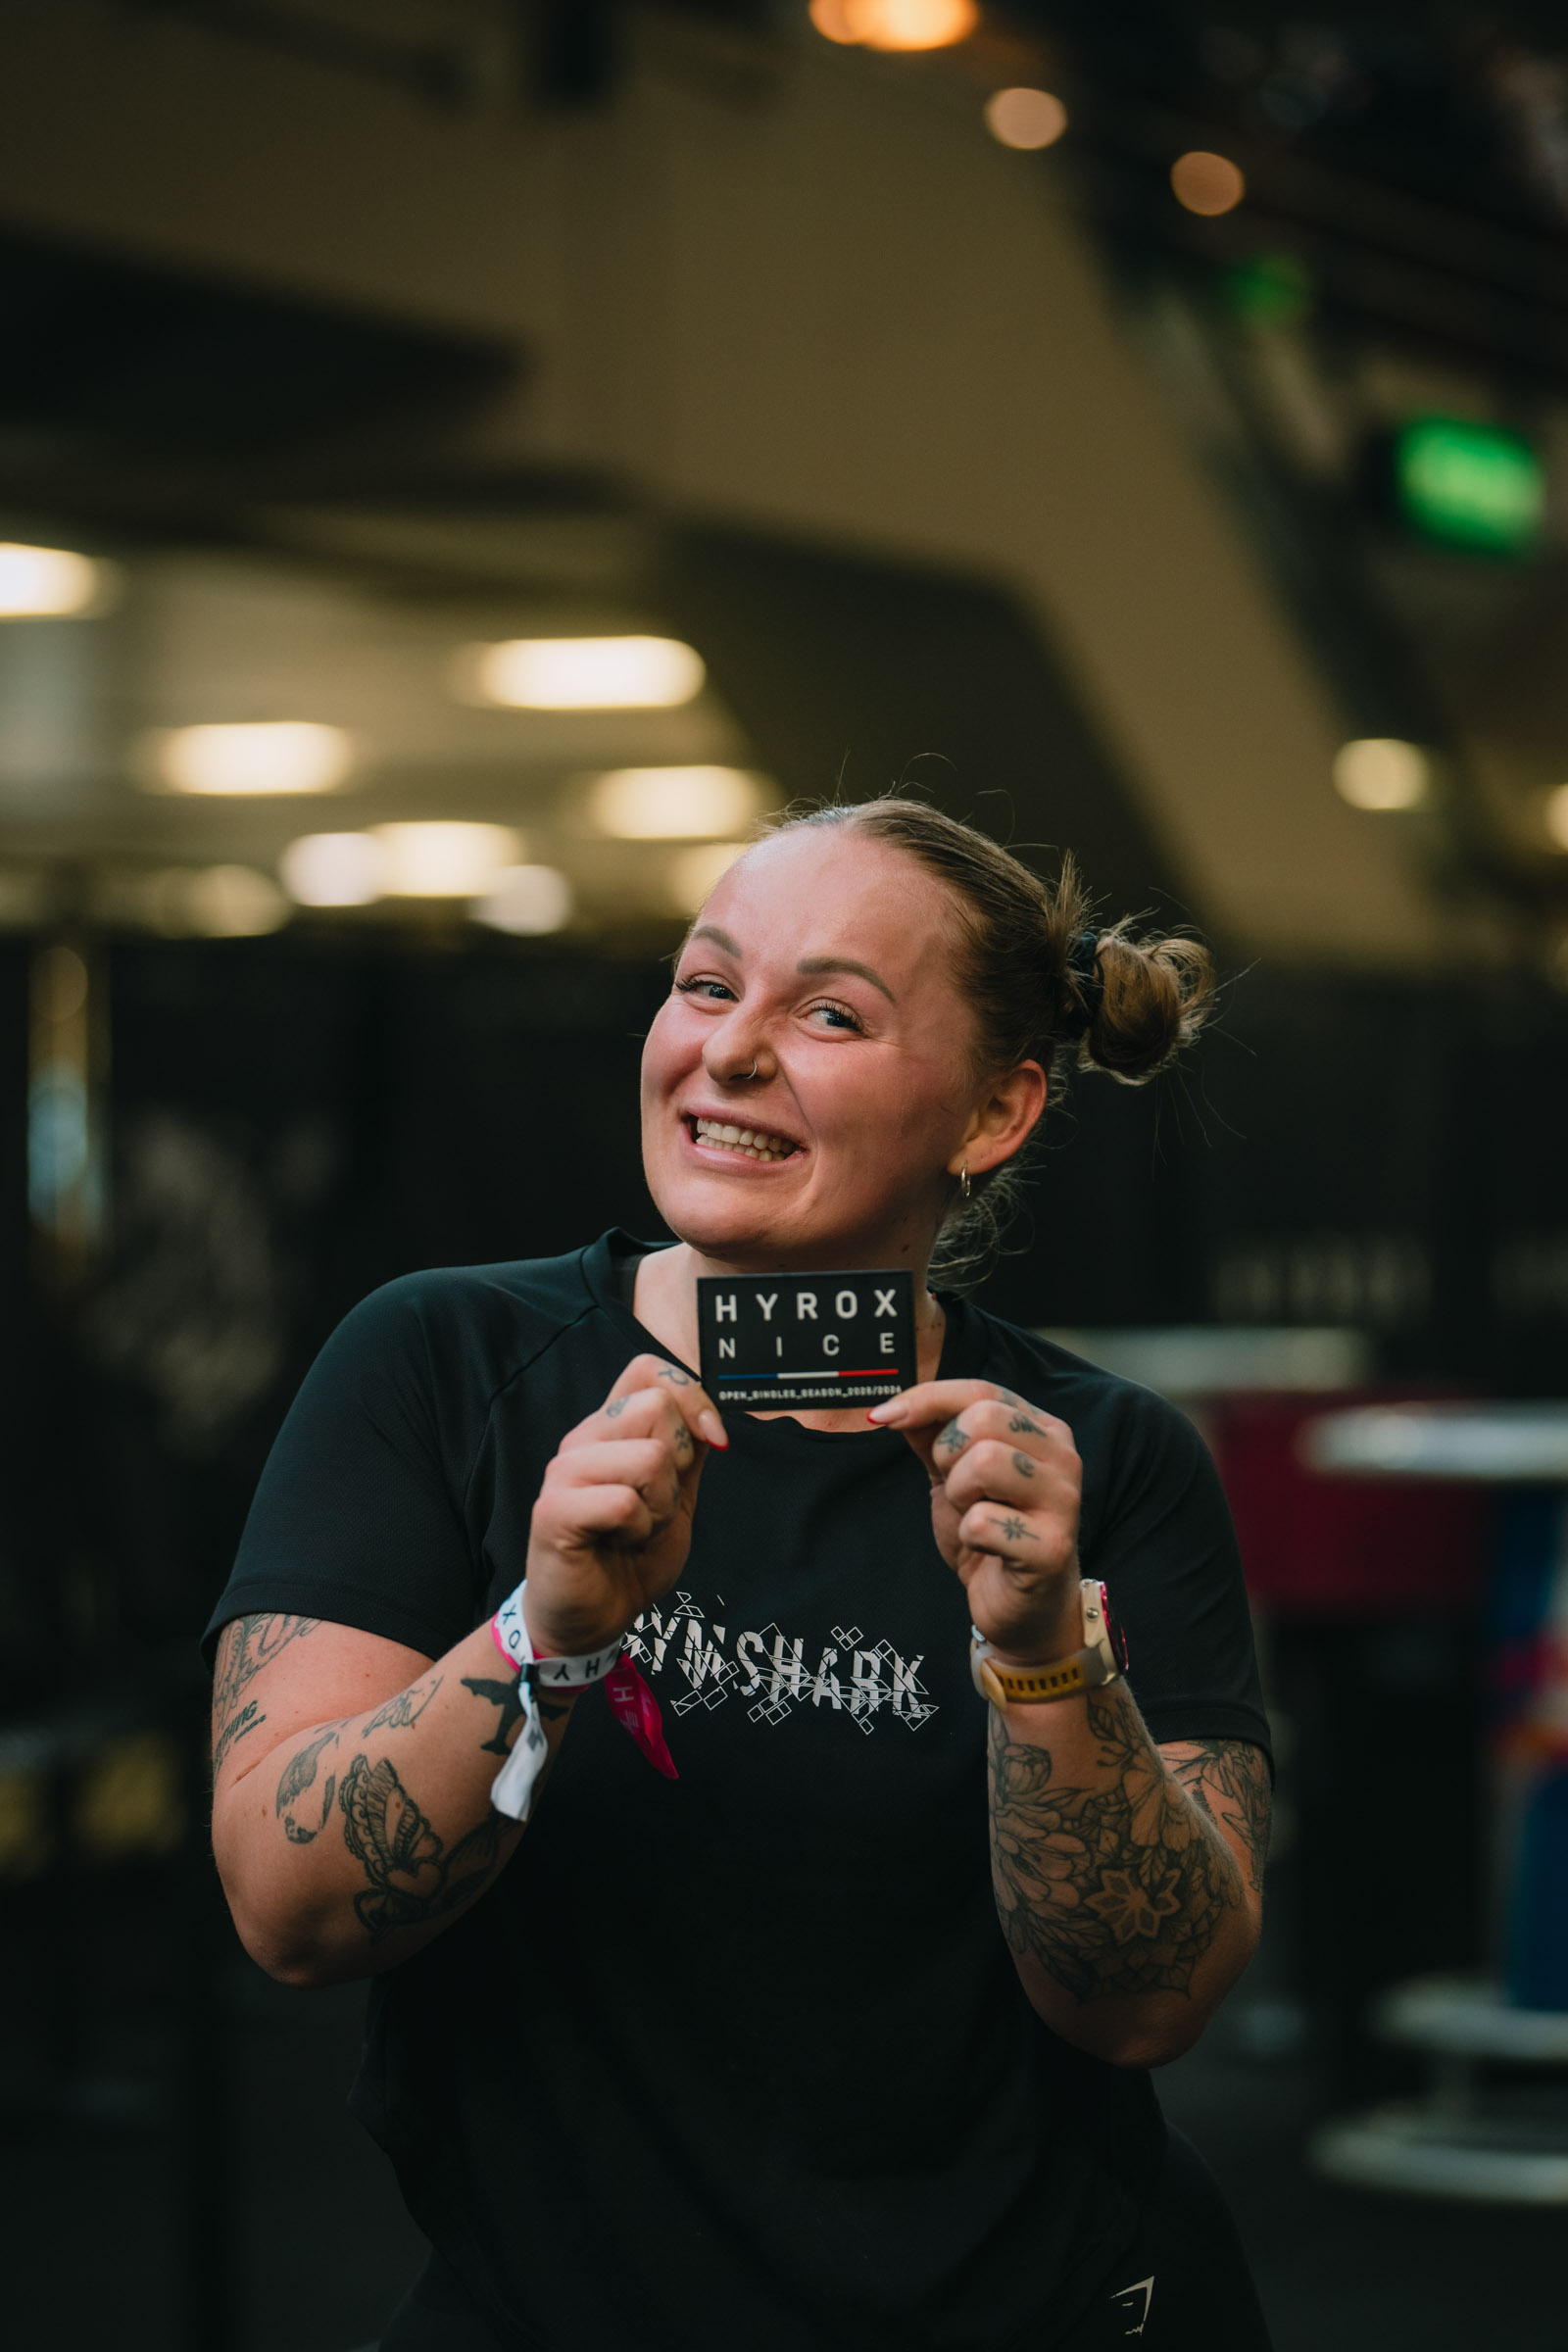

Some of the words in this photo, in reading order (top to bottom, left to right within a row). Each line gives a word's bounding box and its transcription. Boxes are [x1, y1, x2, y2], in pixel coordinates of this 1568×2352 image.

[715, 1289, 897, 1322] HYROX
[718, 1332, 896, 1359] NICE
[622, 1611, 926, 1721] YMSHARK
